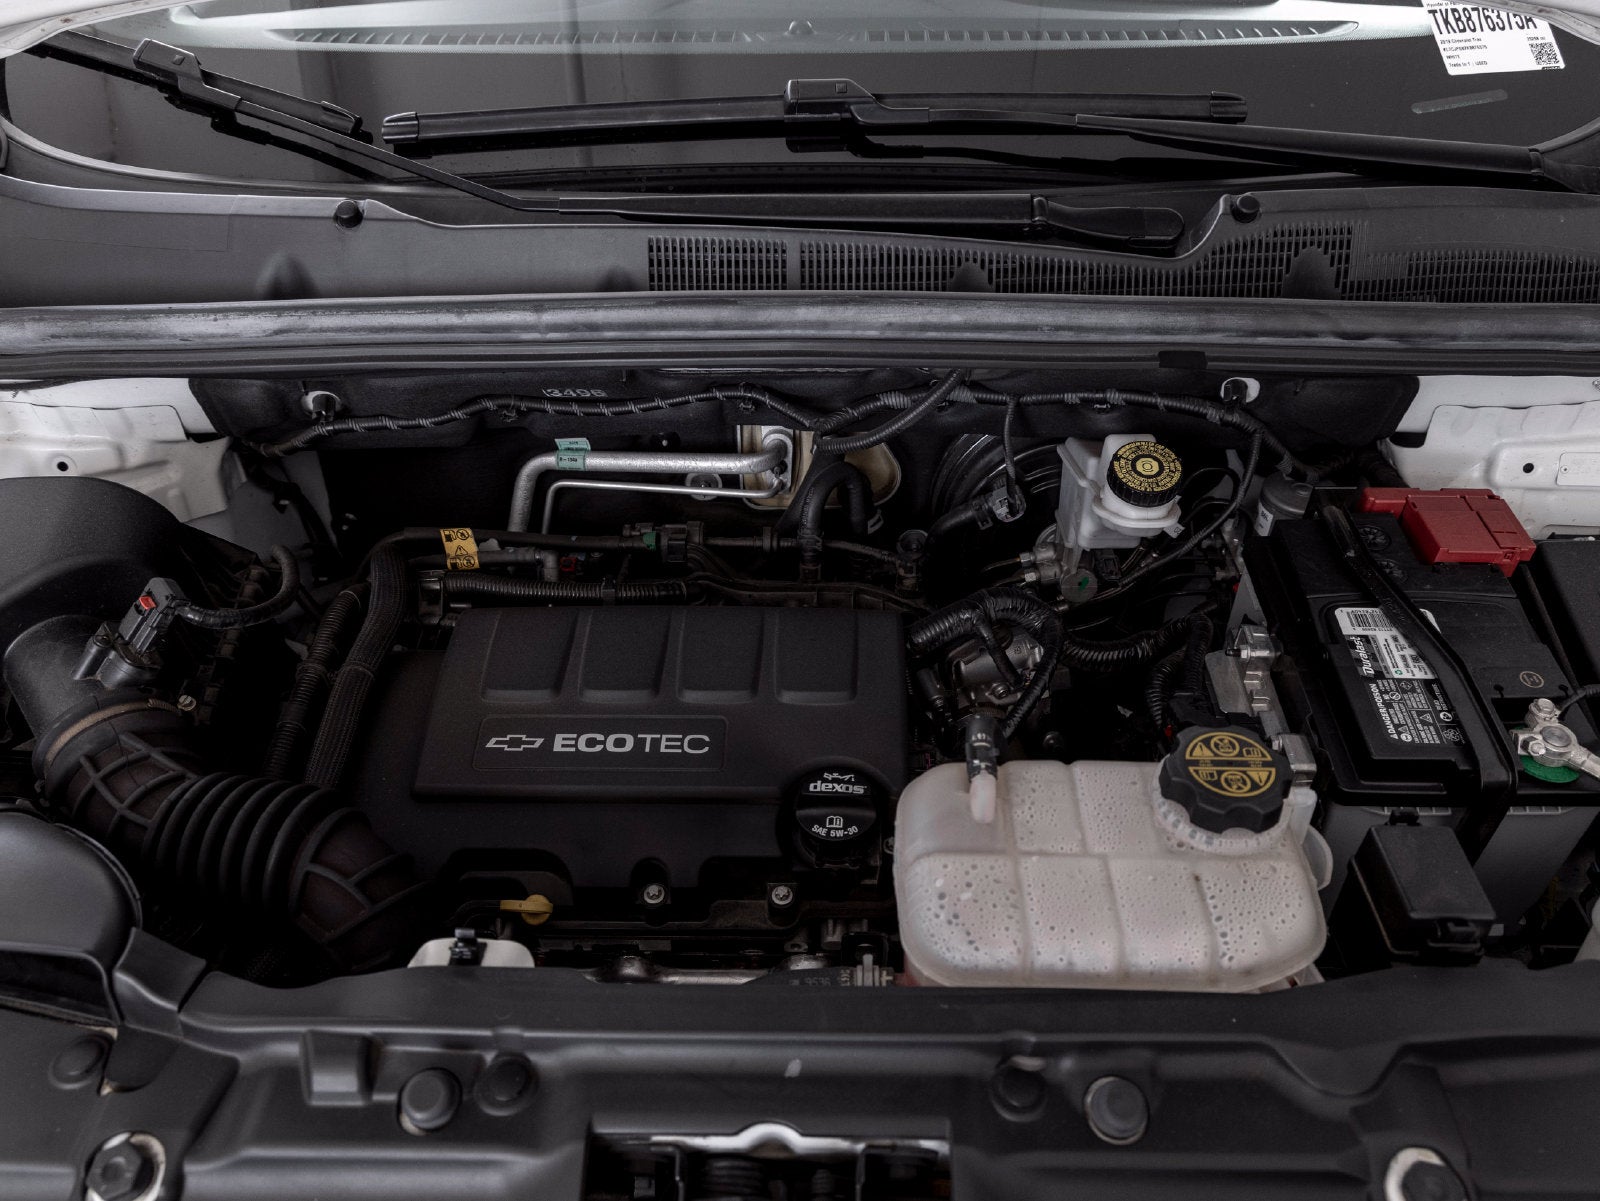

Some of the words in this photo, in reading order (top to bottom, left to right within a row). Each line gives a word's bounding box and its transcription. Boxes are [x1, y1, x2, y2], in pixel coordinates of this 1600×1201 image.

[1349, 636, 1375, 676] Duralast
[553, 733, 711, 754] ECOTEC
[808, 780, 865, 794] dexos
[811, 824, 828, 837] SAE
[830, 825, 859, 838] 5W-30
